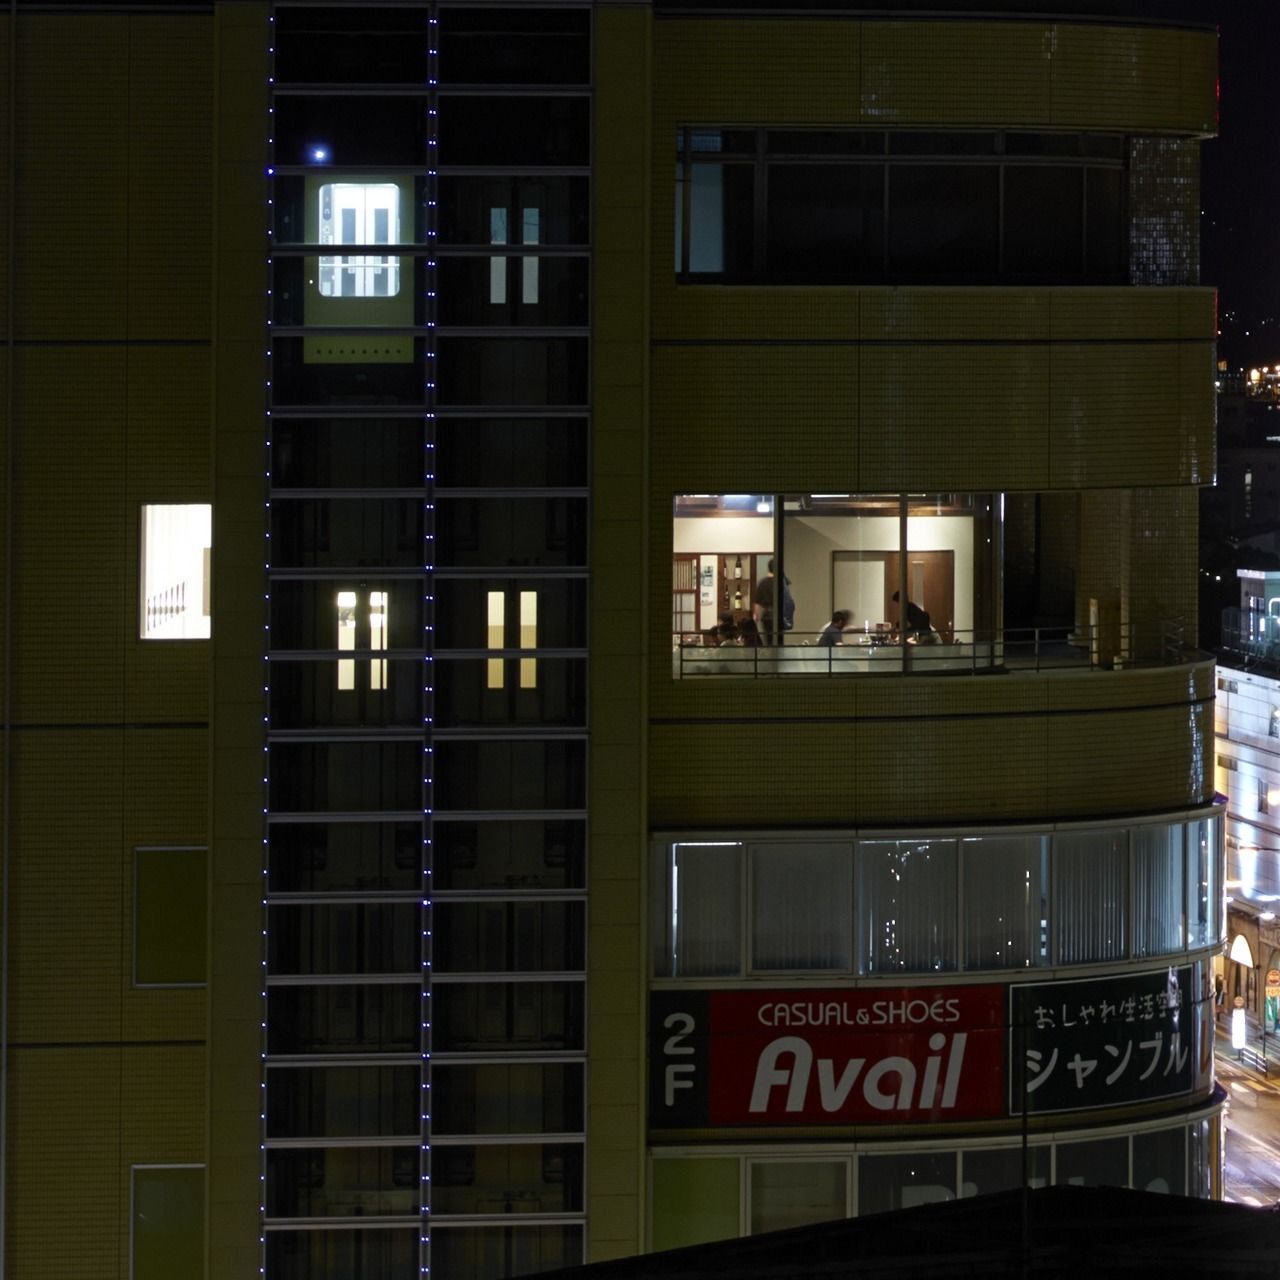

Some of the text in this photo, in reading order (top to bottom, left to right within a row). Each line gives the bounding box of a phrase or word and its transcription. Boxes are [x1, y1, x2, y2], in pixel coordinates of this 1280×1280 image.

[748, 1032, 967, 1113] Avail
[1026, 1031, 1189, 1093] シャンブル
